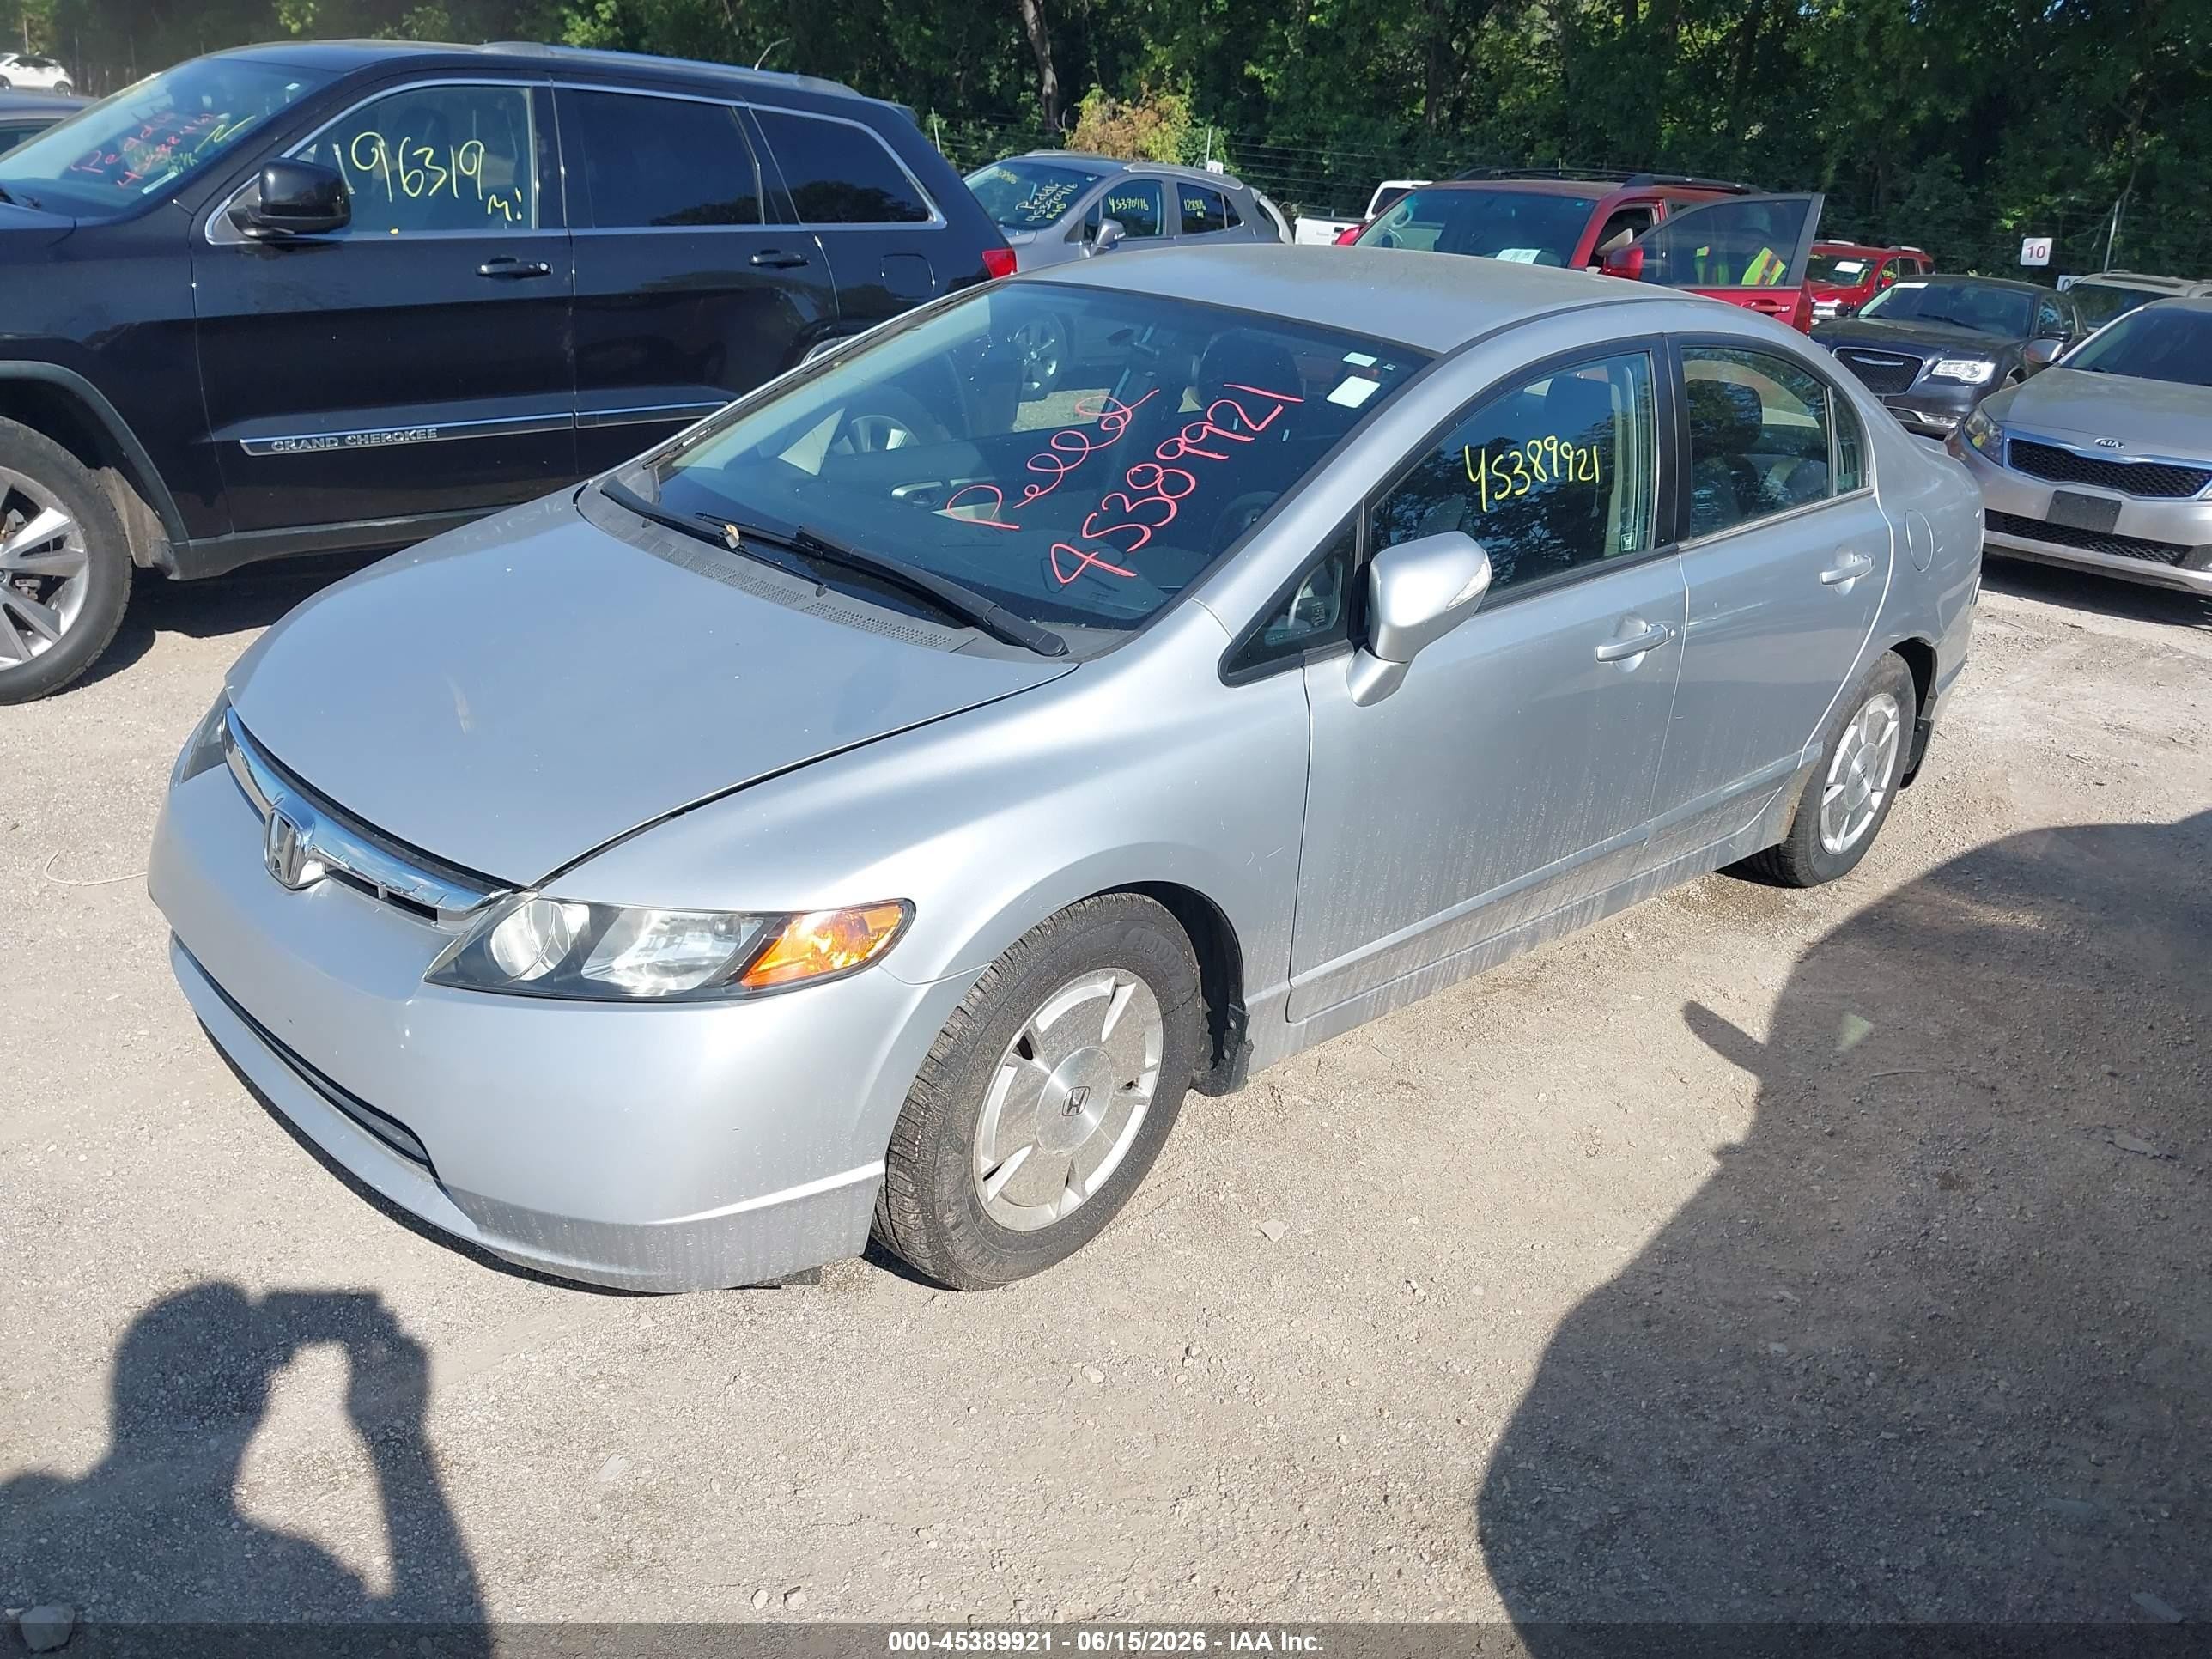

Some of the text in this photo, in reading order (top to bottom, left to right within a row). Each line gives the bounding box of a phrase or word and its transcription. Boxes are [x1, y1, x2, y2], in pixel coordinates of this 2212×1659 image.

[332, 131, 483, 203] 196319
[2027, 245, 2046, 259] 10
[270, 428, 438, 452] GRAND CHEROKEE
[2098, 438, 2122, 448] KIA
[1049, 383, 1305, 585] 45389921
[1464, 434, 1600, 514] 45389921
